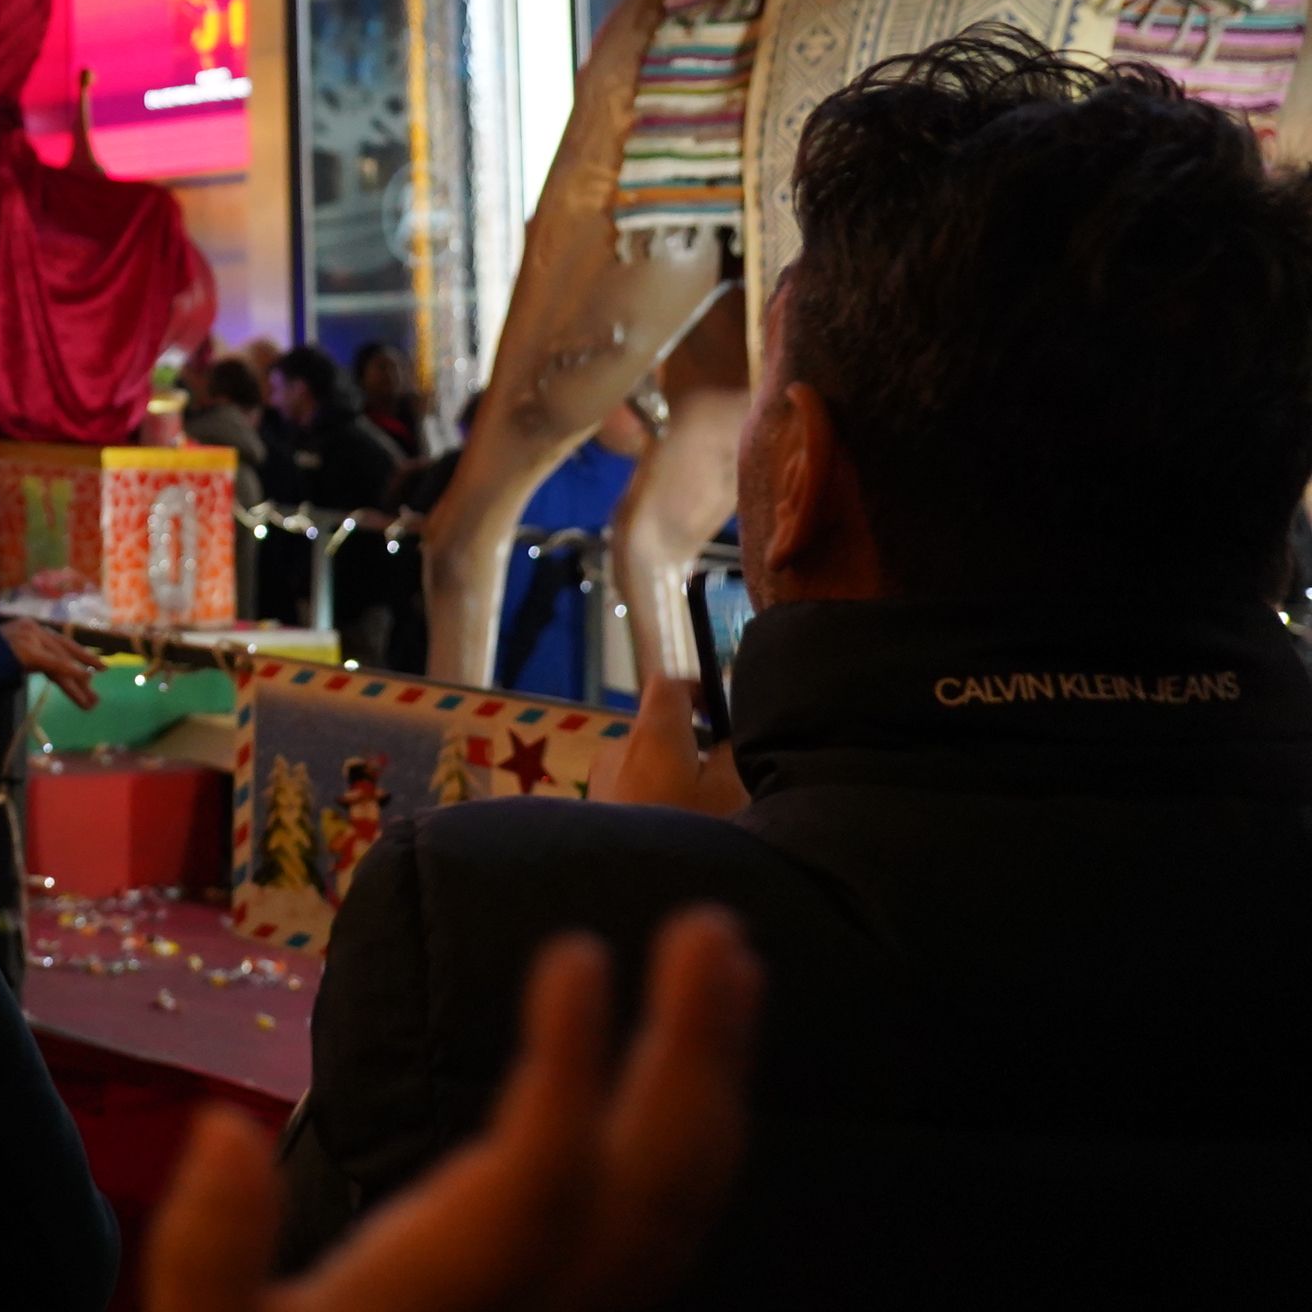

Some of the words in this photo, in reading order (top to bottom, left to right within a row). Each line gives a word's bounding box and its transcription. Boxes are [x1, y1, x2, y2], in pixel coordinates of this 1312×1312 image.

[933, 672, 1055, 707] CALVIN
[1058, 672, 1148, 701] KLEIN
[1147, 671, 1240, 704] JEANS
